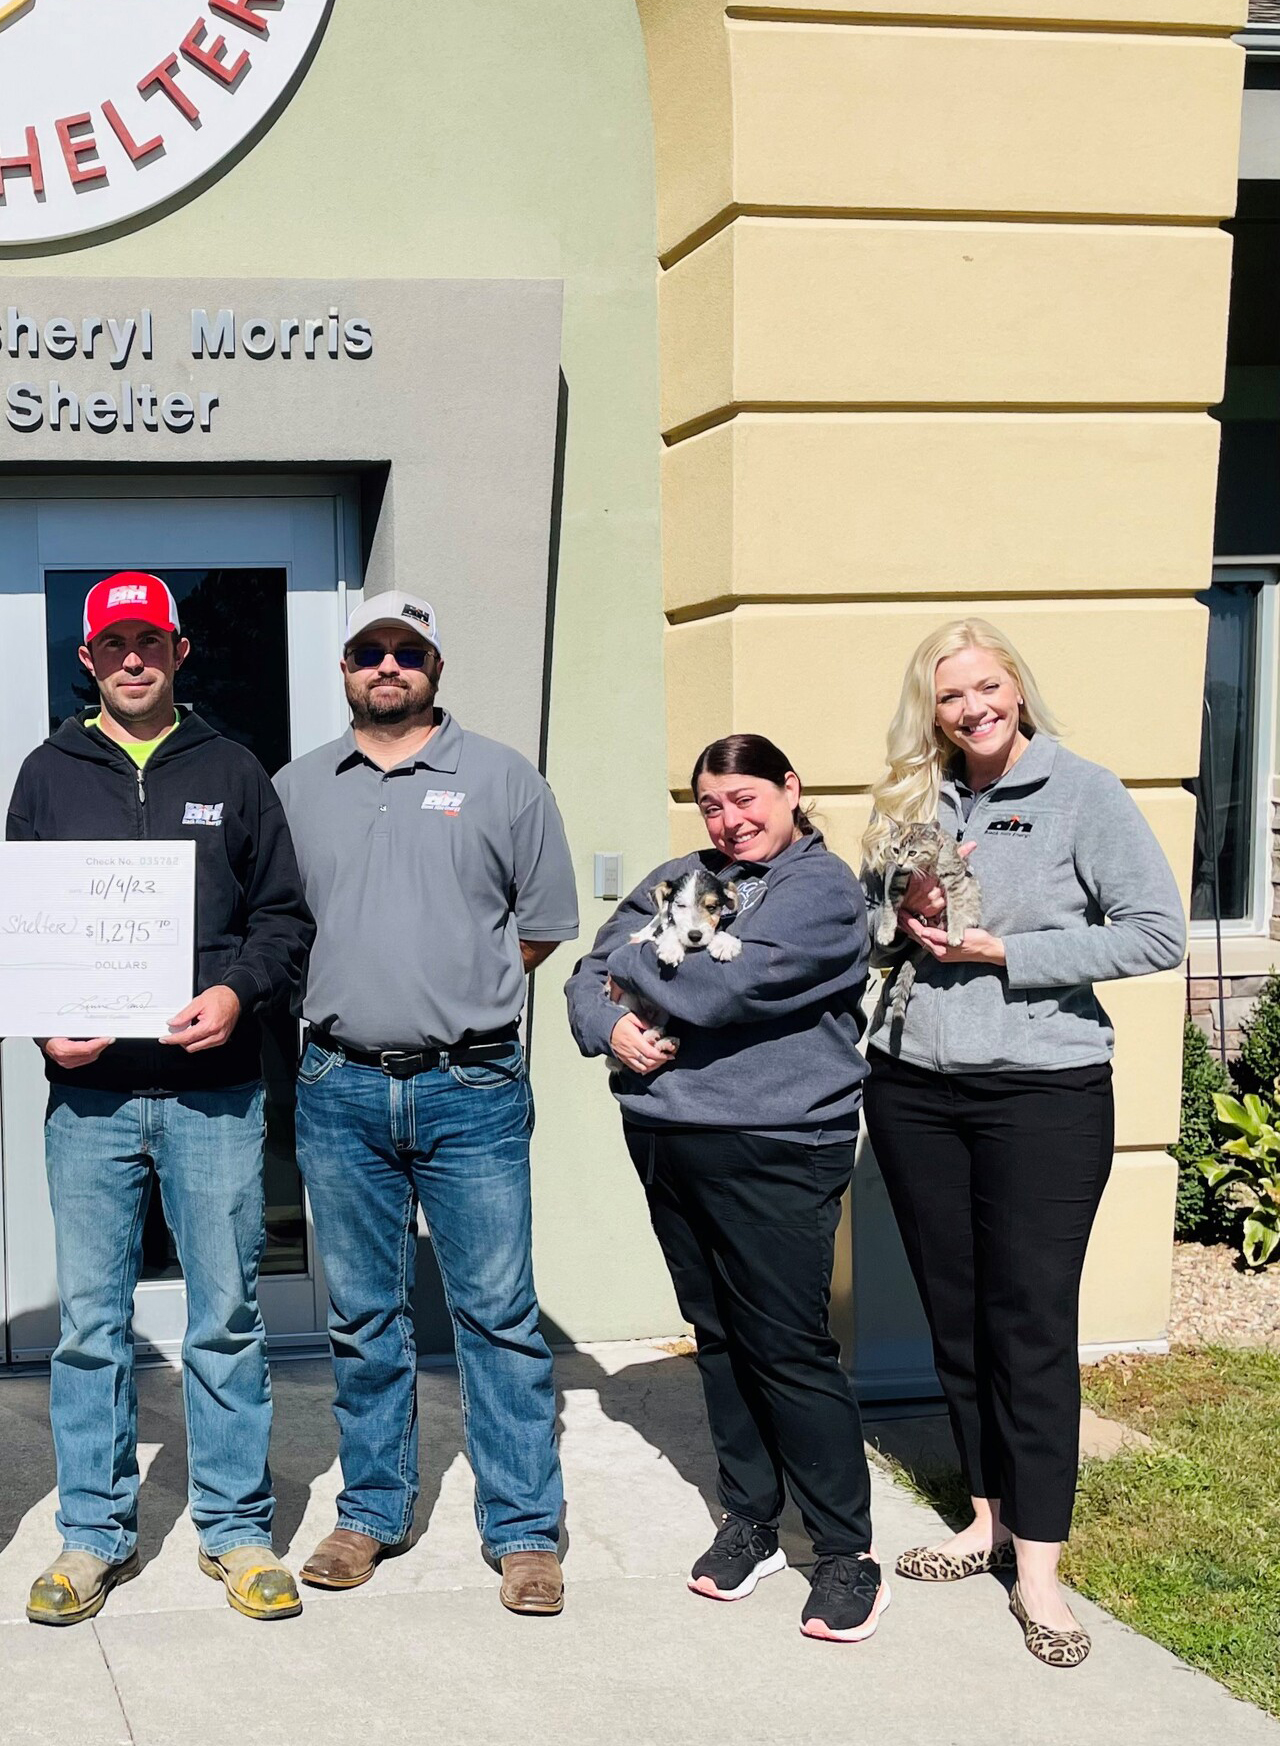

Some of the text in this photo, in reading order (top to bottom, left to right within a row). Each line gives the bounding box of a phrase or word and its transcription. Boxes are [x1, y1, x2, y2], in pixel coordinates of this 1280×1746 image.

[191, 306, 373, 357] Morris
[5, 380, 219, 430] Shelter
[86, 857, 179, 866] Check No. 035782
[90, 874, 156, 903] 10/9/23
[94, 961, 148, 970] DOLLARS
